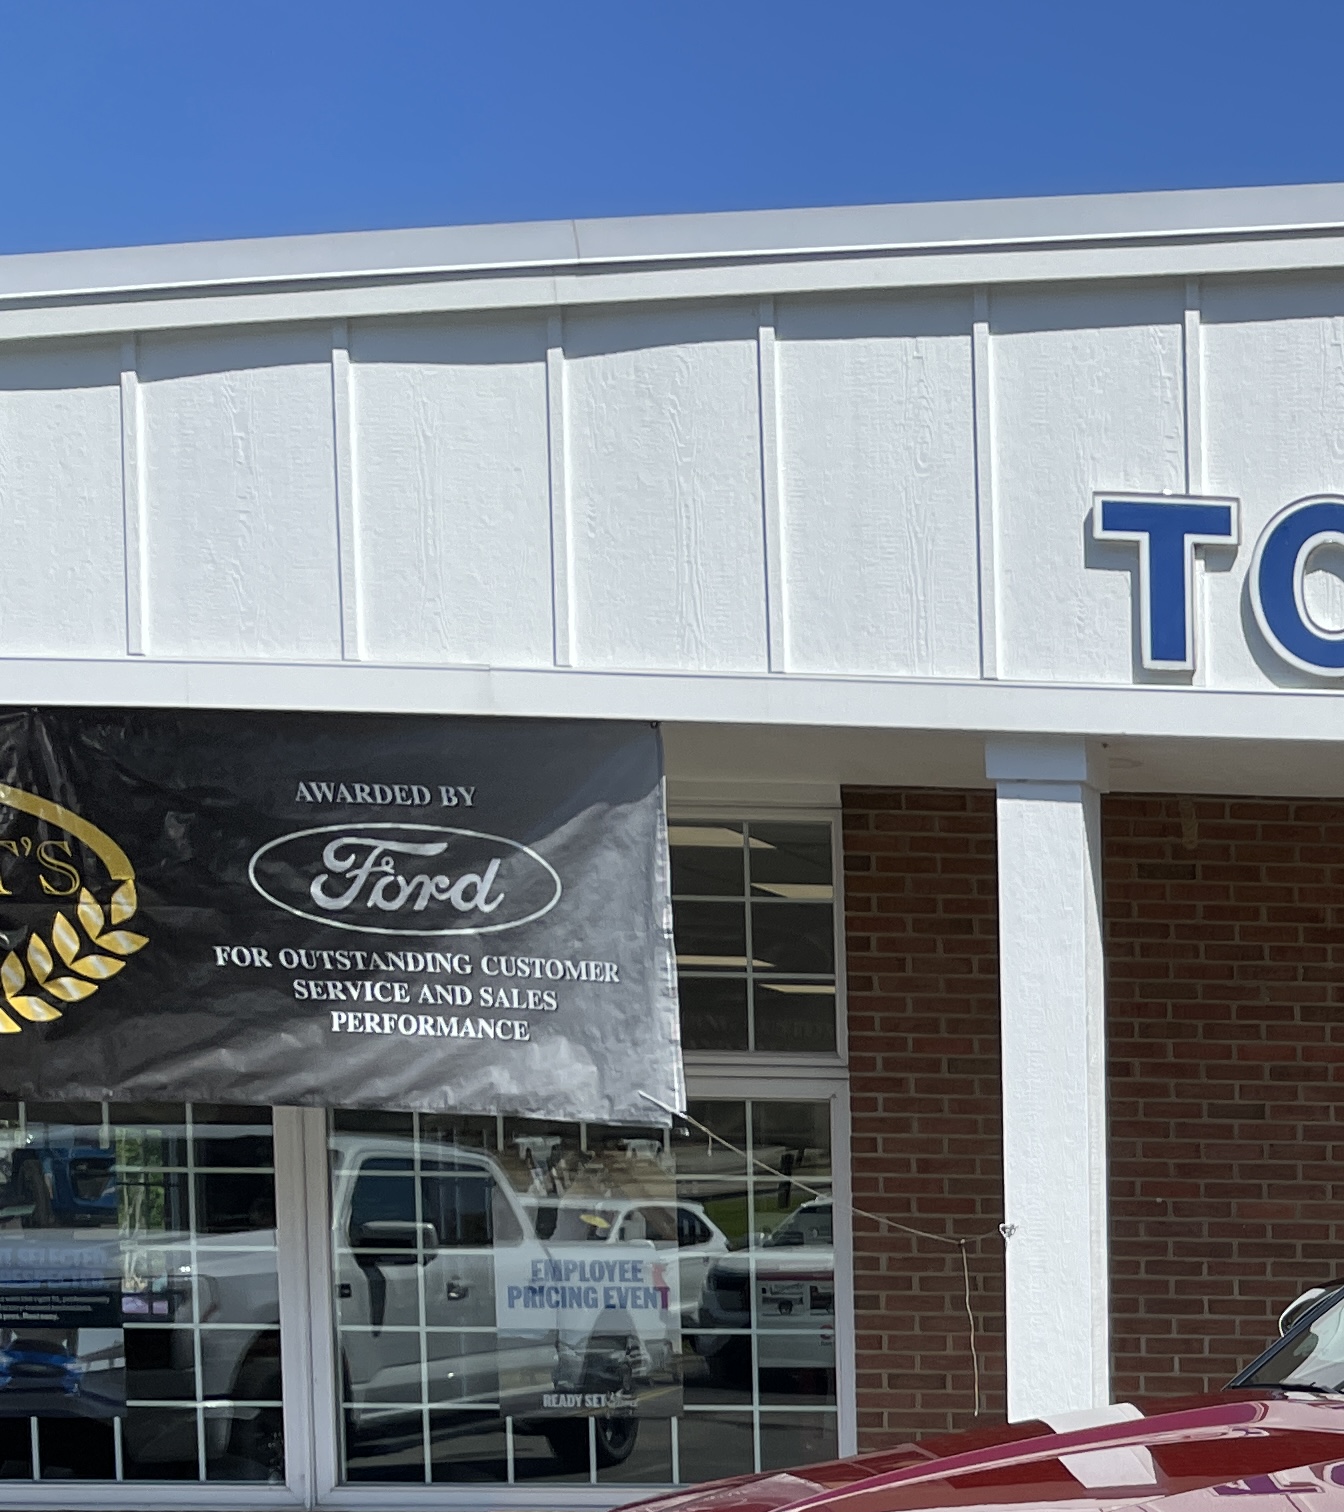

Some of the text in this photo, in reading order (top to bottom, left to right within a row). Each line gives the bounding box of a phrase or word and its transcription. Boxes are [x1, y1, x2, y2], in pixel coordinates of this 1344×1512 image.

[295, 782, 476, 807] AWARDED BY
[310, 837, 504, 912] Ford
[213, 945, 620, 982] FOR OUTSTANDING CUSTOMER
[293, 980, 558, 1011] SERVICE AND SALES
[330, 1011, 531, 1041] PERFORMANCE
[531, 1259, 643, 1283] EMPLOYEE
[507, 1285, 670, 1310] PRICING EVENT
[543, 1394, 583, 1409] READY
